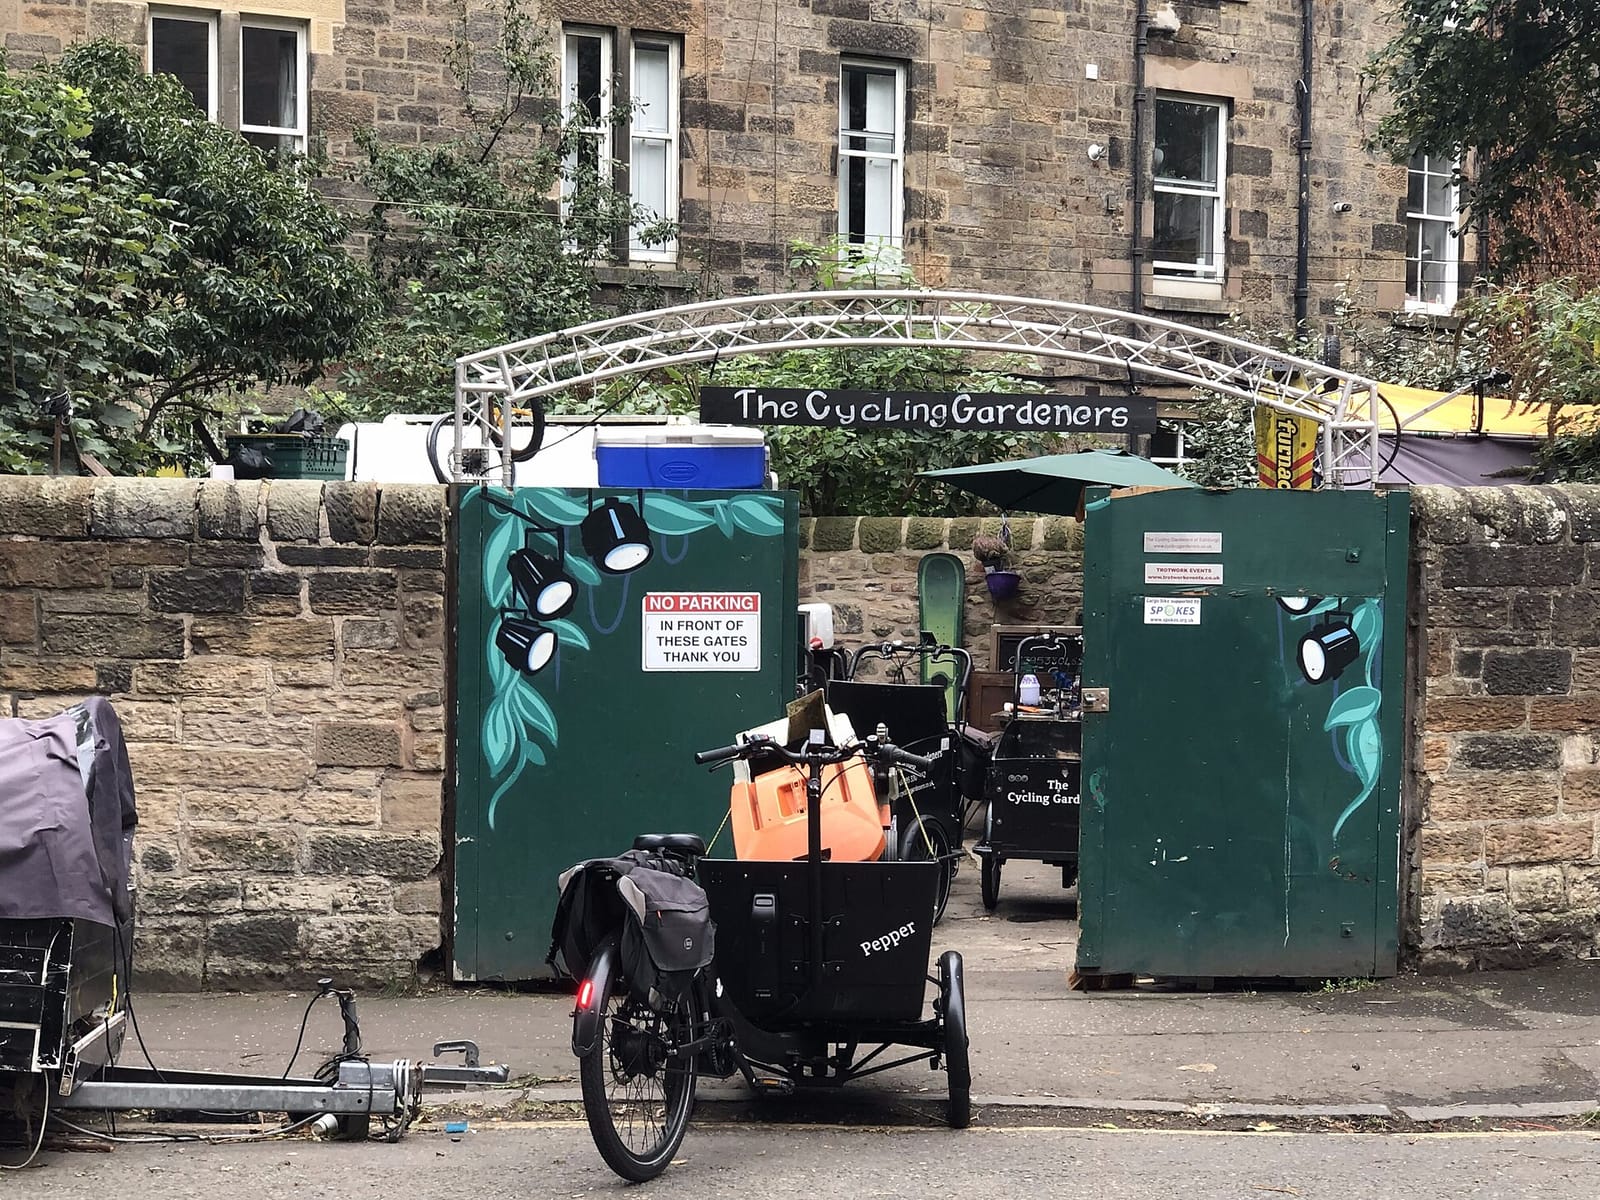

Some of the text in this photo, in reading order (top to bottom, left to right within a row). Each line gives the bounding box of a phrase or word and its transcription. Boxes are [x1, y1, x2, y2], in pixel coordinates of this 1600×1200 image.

[733, 389, 798, 420] The
[650, 596, 753, 610] NO PARKING
[1150, 605, 1195, 616] SPOKES
[660, 620, 744, 631] IN FRONT OF
[656, 636, 747, 646] THESE GATES
[663, 651, 740, 662] THANK YOU
[1047, 779, 1069, 790] The
[1007, 791, 1081, 806] Cycling Gard
[859, 921, 916, 957] Pepper
